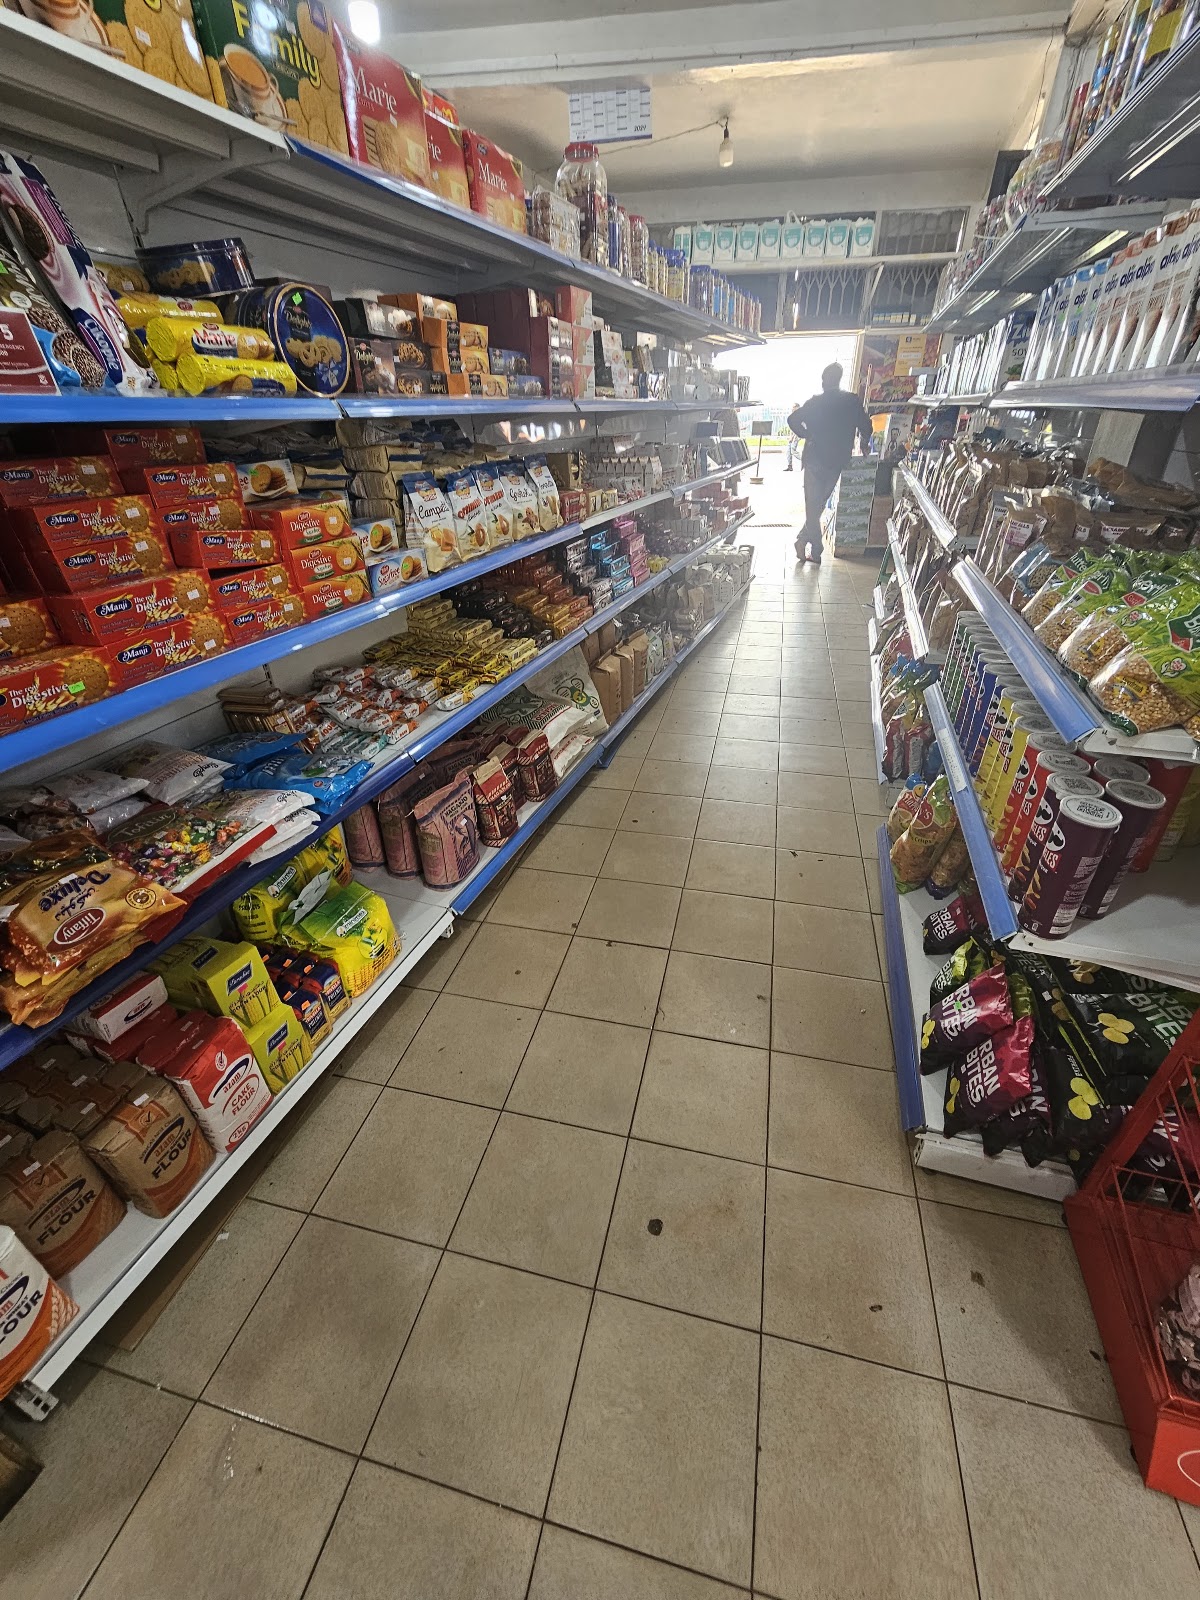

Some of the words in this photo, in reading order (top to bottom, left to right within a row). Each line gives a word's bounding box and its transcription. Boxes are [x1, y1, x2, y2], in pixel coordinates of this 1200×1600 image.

[231, 0, 322, 89] Fmily
[477, 157, 508, 193] Marie
[39, 474, 80, 485] Digestive
[50, 516, 76, 527] Manji
[82, 514, 121, 528] Digestive
[289, 517, 321, 532] Digestive
[68, 556, 93, 567] Manji
[99, 554, 137, 567] Digestive
[300, 554, 333, 570] Digestive
[100, 600, 129, 615] Manji
[133, 595, 145, 604] The
[135, 596, 178, 614] Digestive
[311, 590, 342, 605] Digestive
[121, 645, 150, 662] Manji
[153, 640, 165, 649] The
[155, 638, 196, 658] Digestive
[8, 689, 24, 699] The
[11, 682, 70, 709] Digestive
[38, 869, 112, 912] Deluxe
[62, 911, 101, 941] Tiffany
[939, 908, 959, 936] RBAN
[940, 992, 962, 1038] BITES
[954, 982, 979, 1030] RBAN
[965, 1049, 986, 1104] BITES
[979, 1038, 1002, 1096] RBAN
[222, 1072, 242, 1094] azam
[231, 1082, 251, 1107] CAKE
[231, 1086, 257, 1117] FLOUR
[151, 1127, 193, 1180] FLOUR
[153, 1132, 178, 1159] azam
[36, 1189, 97, 1247] FLOUR
[0, 1289, 44, 1345] LOUR
